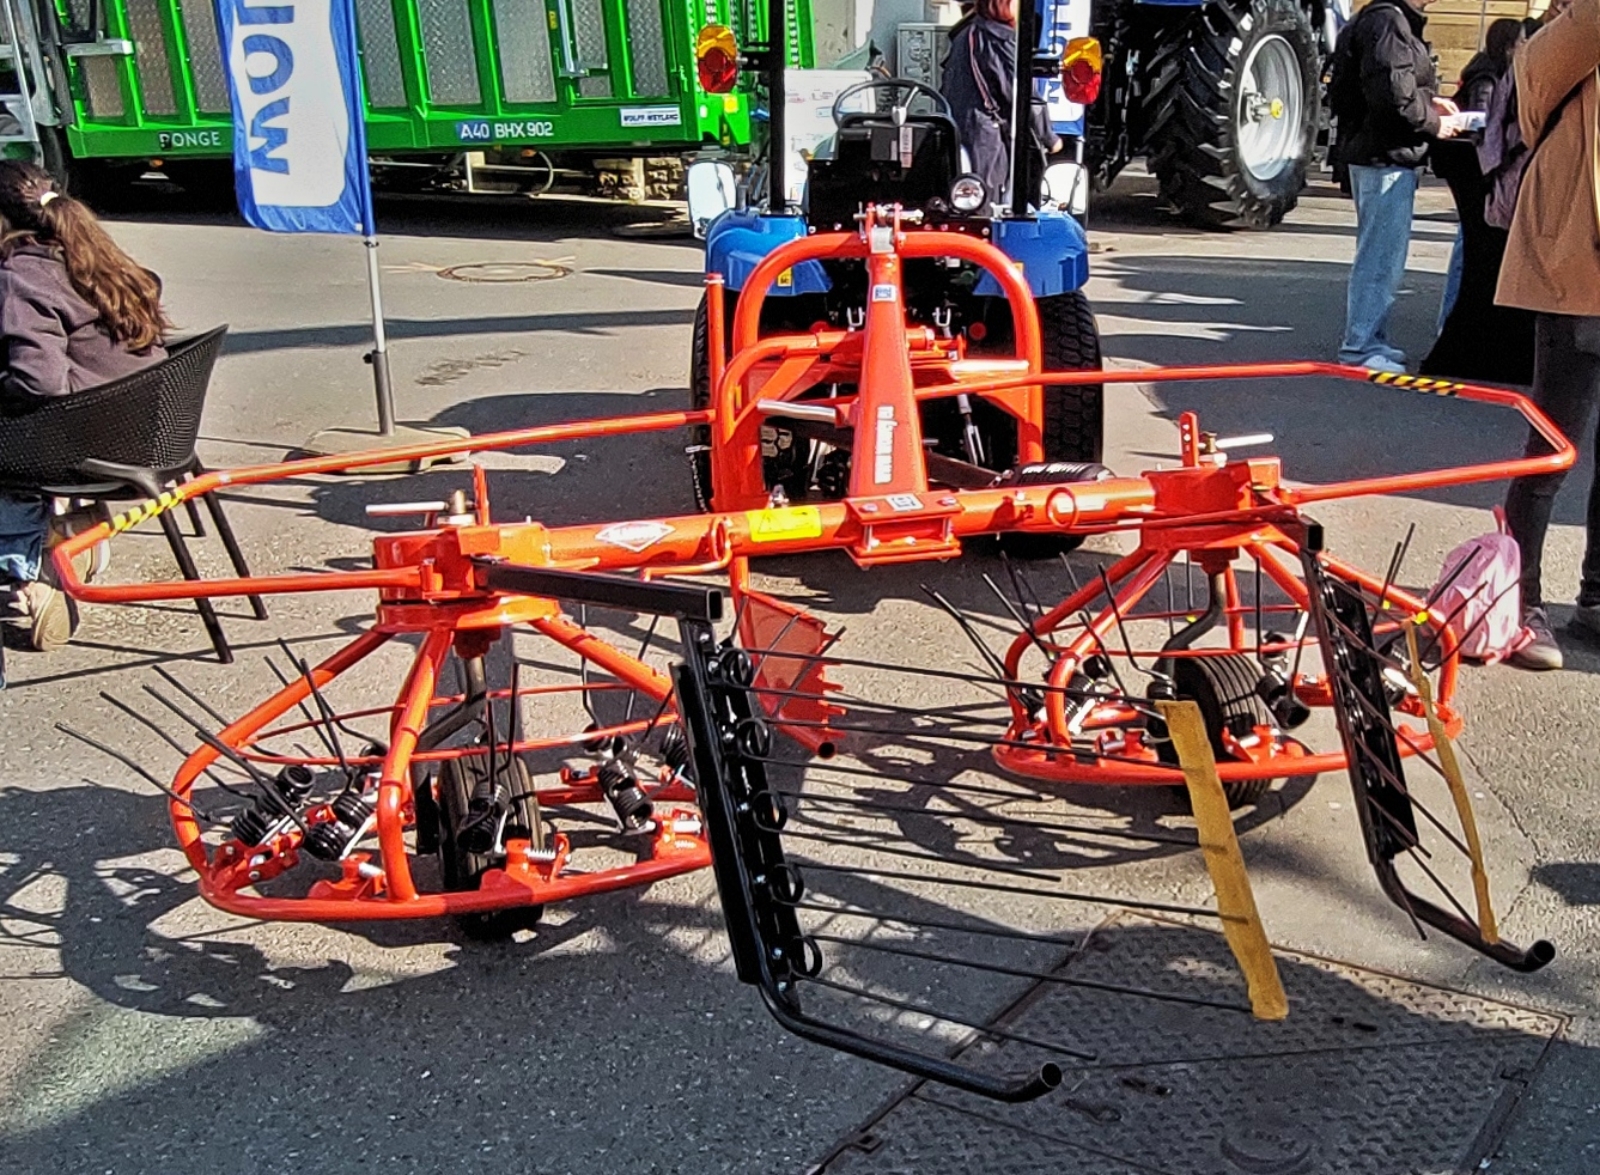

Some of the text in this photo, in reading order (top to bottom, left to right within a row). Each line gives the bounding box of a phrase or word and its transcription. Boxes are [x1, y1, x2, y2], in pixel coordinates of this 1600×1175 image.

[461, 121, 554, 139] A40 BHX 902
